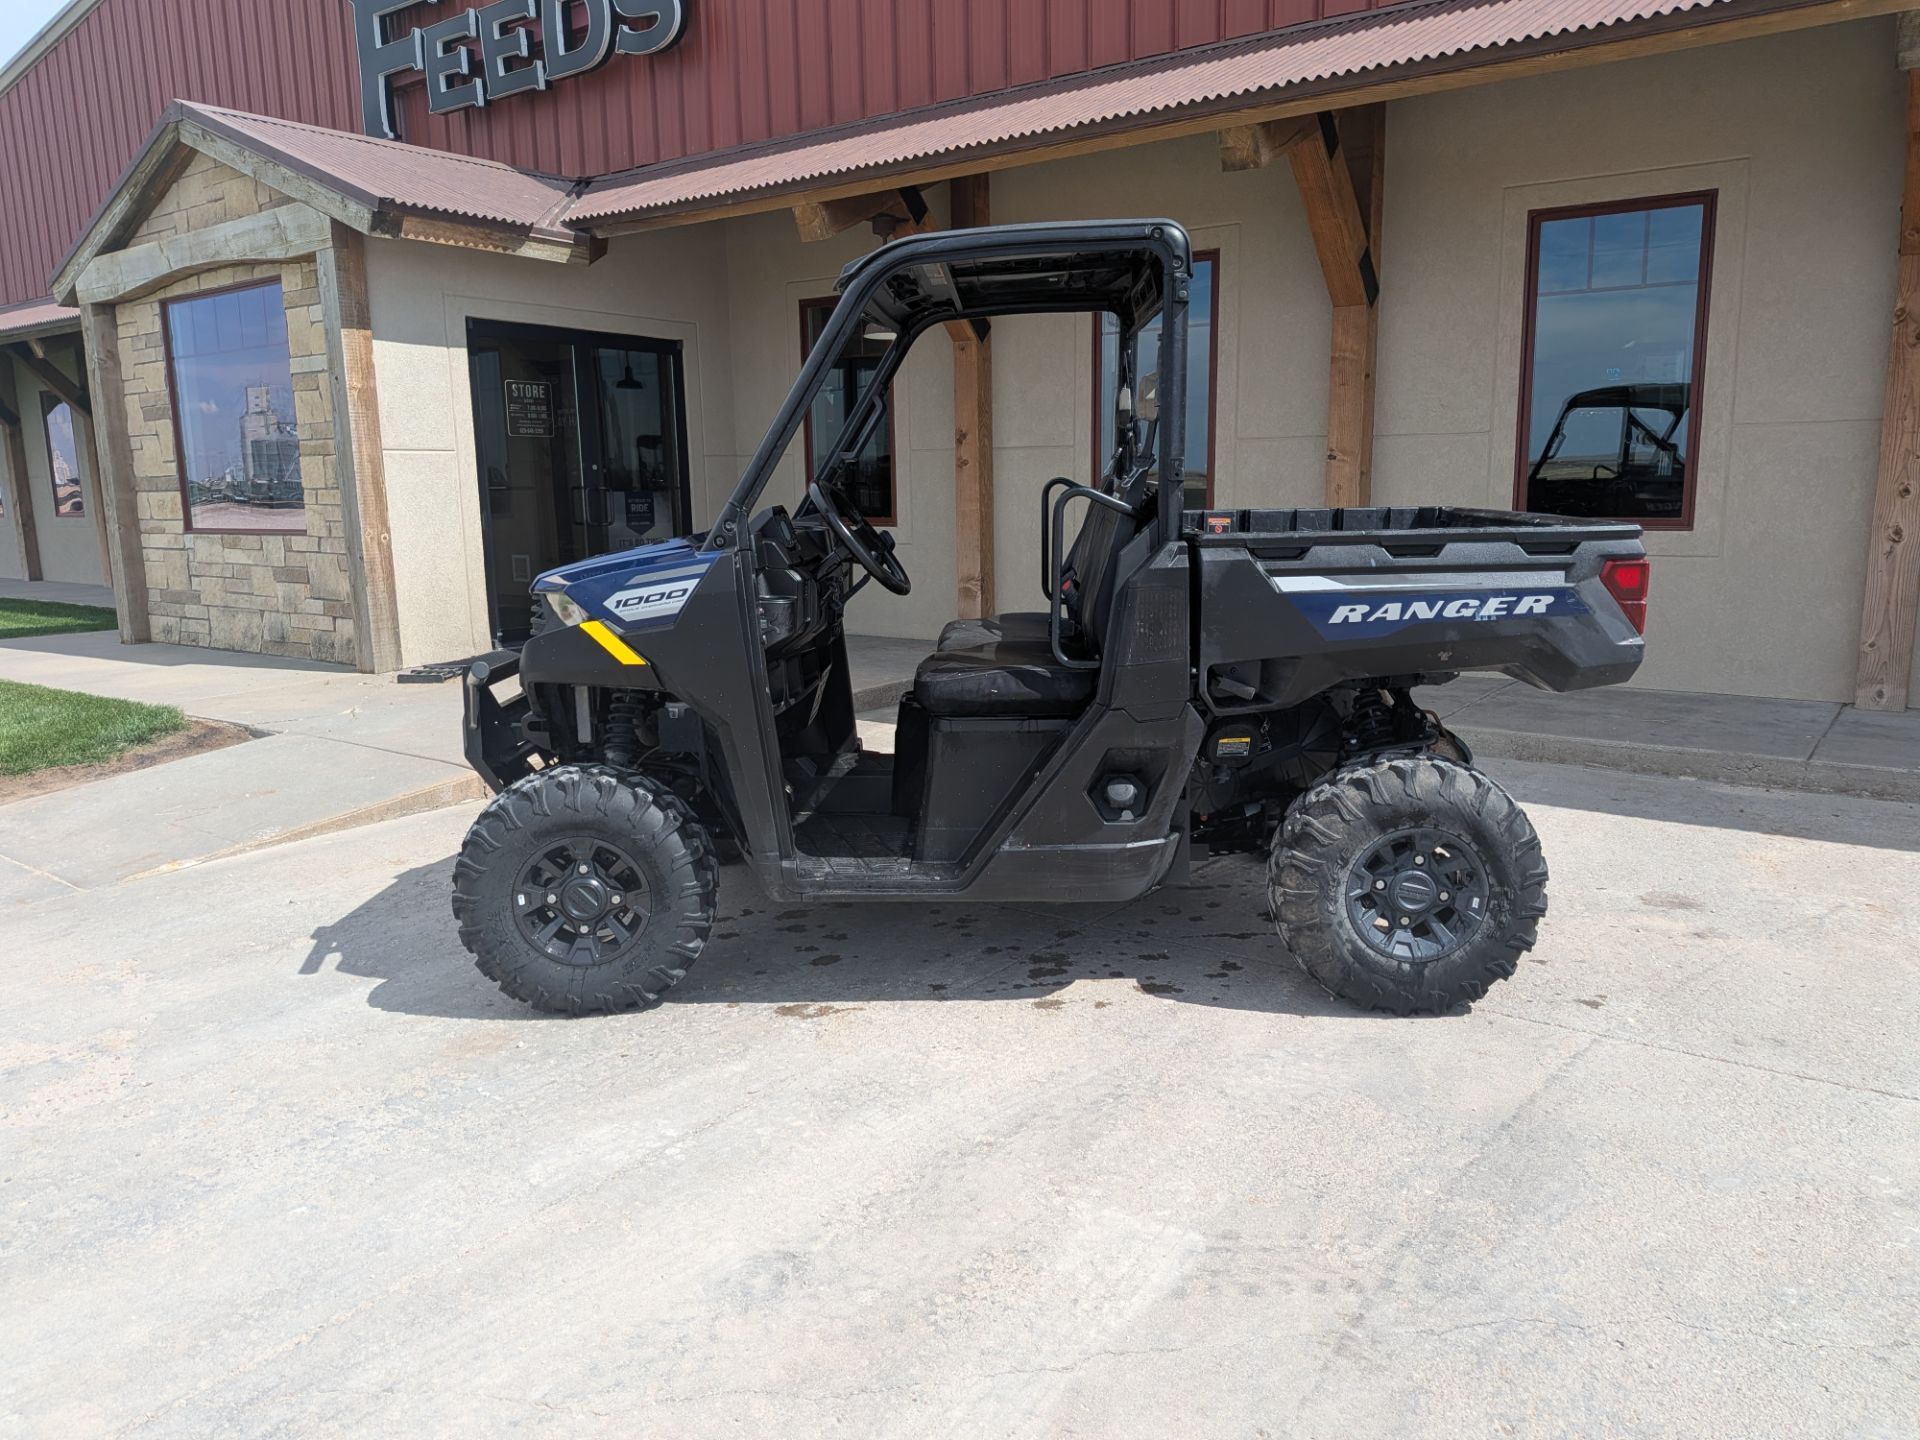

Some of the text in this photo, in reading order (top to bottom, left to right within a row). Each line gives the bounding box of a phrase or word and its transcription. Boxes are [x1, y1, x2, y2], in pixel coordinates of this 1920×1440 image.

[353, 0, 684, 138] FEEDS
[512, 384, 545, 398] STORE
[631, 503, 649, 512] RIDE
[614, 588, 689, 609] 1000
[1328, 595, 1555, 624] RANGER
